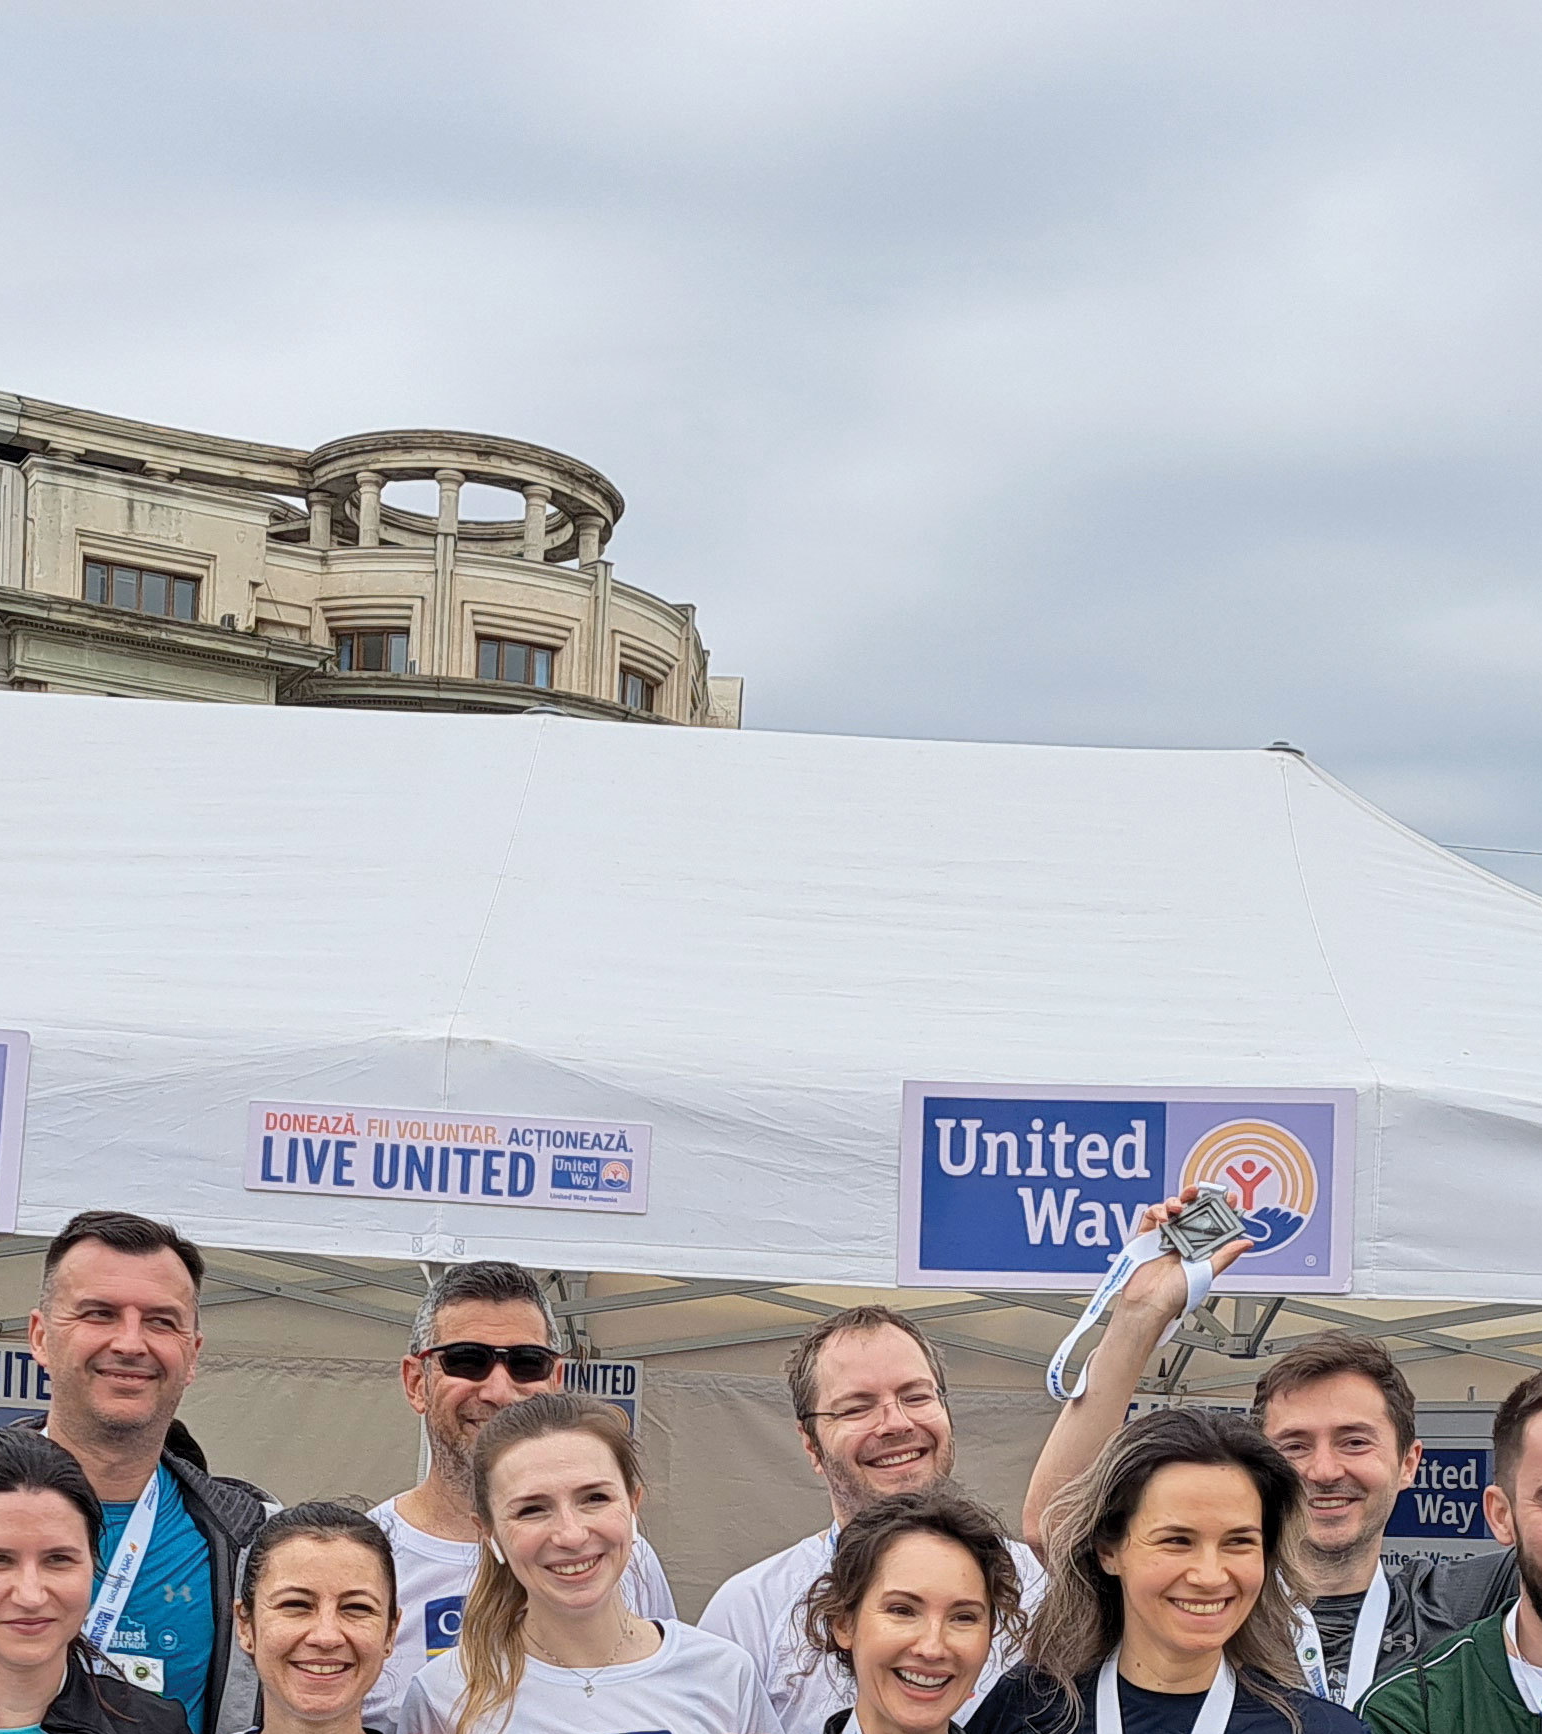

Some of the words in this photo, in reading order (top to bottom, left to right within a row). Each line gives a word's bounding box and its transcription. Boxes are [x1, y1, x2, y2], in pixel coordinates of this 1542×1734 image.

[265, 1112, 360, 1137] DONEAZĂ.
[367, 1118, 390, 1138] FII
[396, 1120, 502, 1146] VOLUNTAR.
[935, 1118, 1150, 1179] United
[261, 1135, 357, 1187] LIVE
[373, 1143, 535, 1198] UNITED
[554, 1157, 597, 1174] United
[570, 1172, 597, 1188] Way
[564, 1363, 636, 1396] UNITED
[1410, 1459, 1478, 1490] ited
[1414, 1494, 1478, 1534] Way
